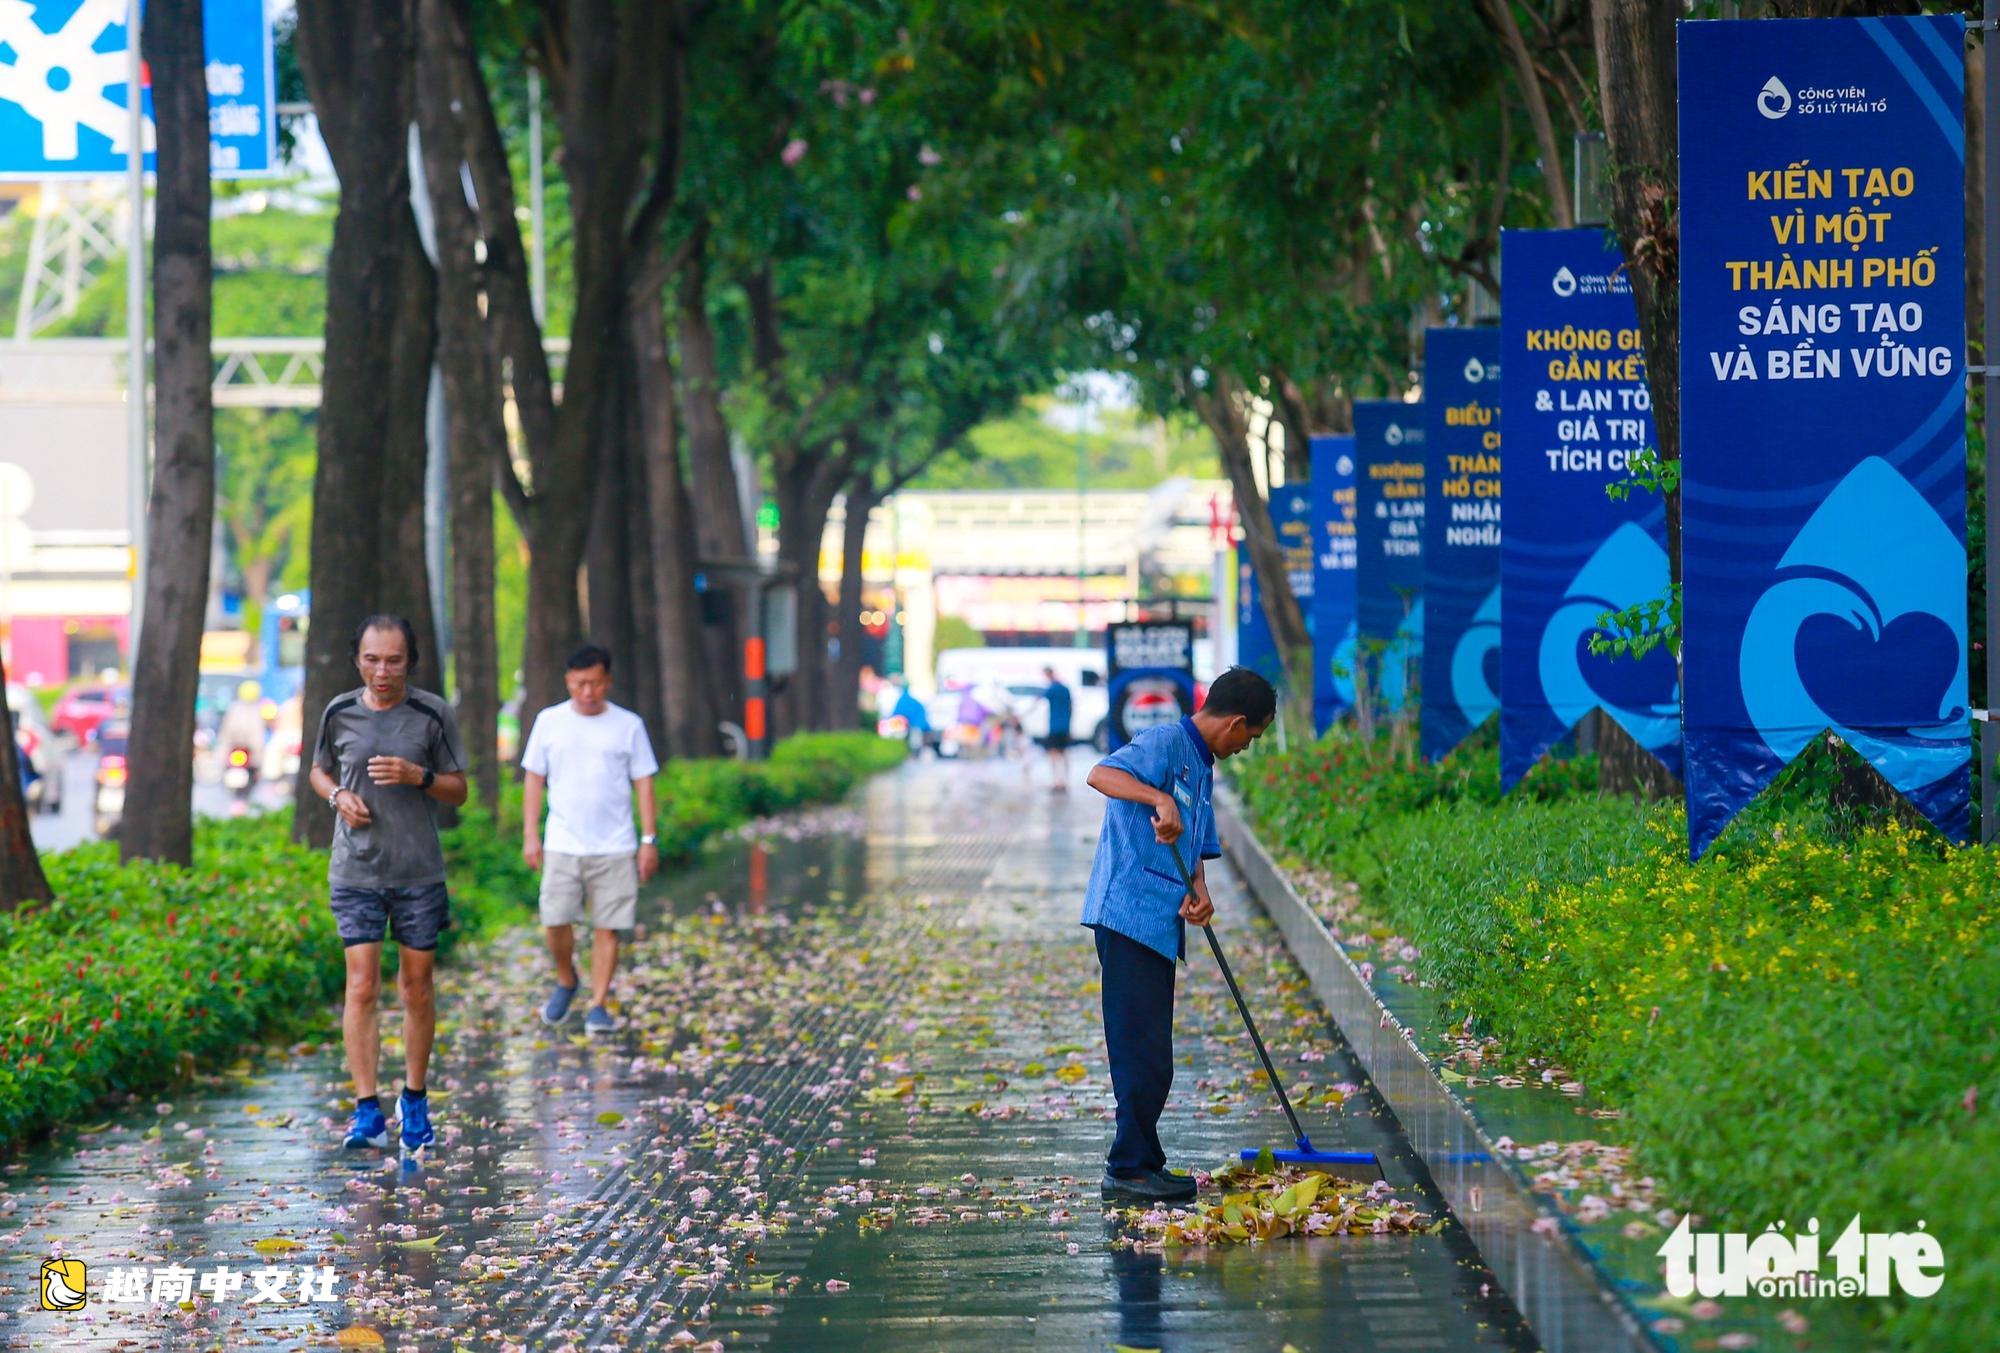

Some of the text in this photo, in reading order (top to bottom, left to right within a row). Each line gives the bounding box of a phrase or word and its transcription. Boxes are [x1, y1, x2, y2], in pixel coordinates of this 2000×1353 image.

[1798, 86, 1866, 99] CÔNG VIÊN
[1798, 100, 1815, 113] SỐ
[1817, 104, 1822, 113] 1
[1825, 101, 1838, 113] LÝ
[1840, 100, 1868, 112] THÁI
[1748, 160, 1914, 206] KIẾN TẠO
[1771, 206, 1891, 251] VÌ MỘT
[1725, 246, 1939, 290] THÀNH PHỐ
[1738, 299, 1923, 342] SÁNG TẠO
[1526, 324, 1644, 352] KHÔNG GI
[1710, 338, 1952, 380] VÀ BỀN VỮNG
[1535, 382, 1653, 411] & LAN TỎ
[1557, 414, 1645, 446] GIÁ TRỊ
[1545, 444, 1602, 471] TÍCH
